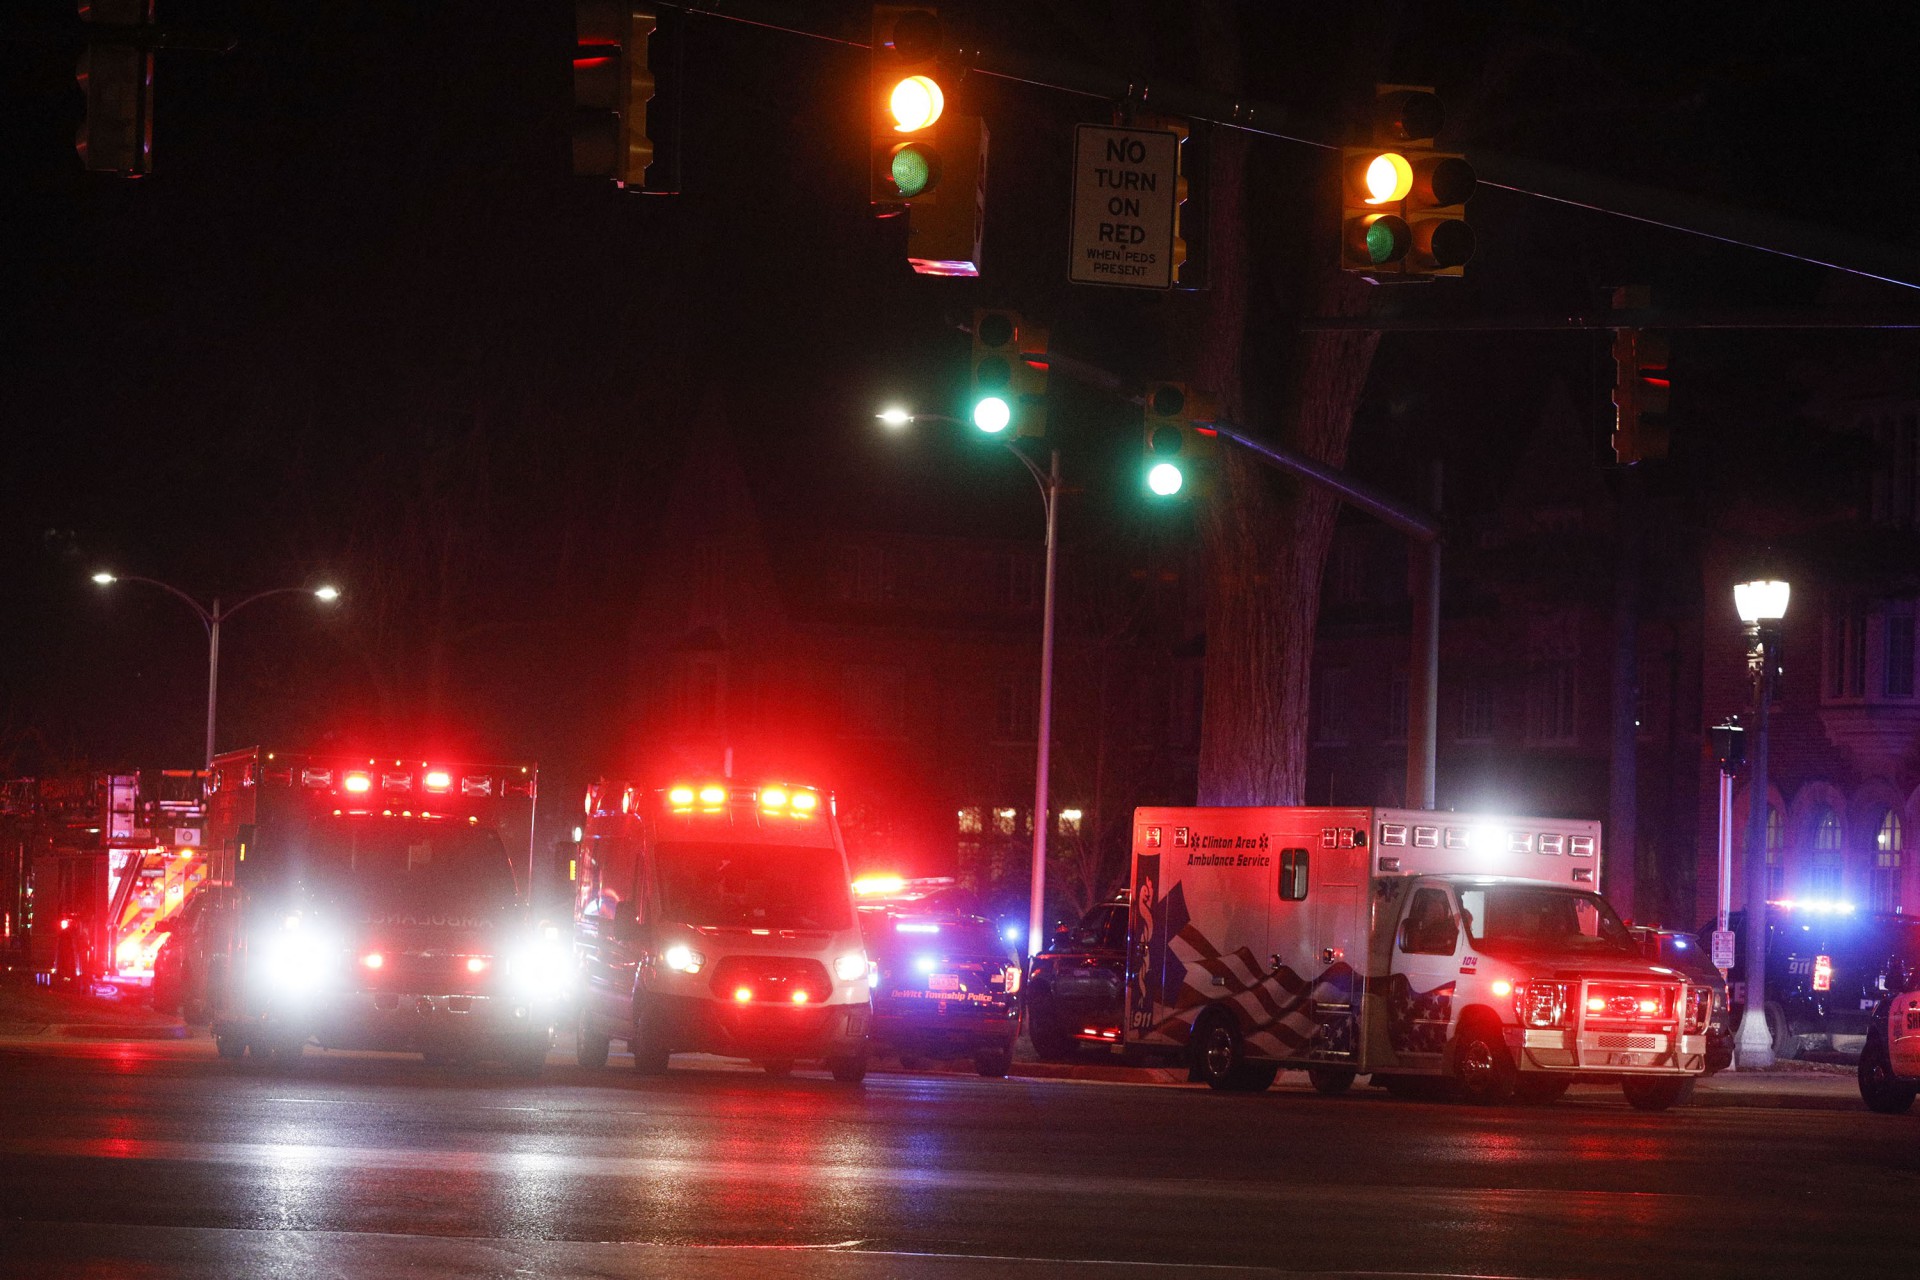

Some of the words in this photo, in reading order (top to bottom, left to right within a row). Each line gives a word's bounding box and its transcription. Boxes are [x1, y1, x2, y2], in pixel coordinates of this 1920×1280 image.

[1107, 139, 1146, 164] NO
[1094, 168, 1156, 192] TURN
[1108, 197, 1140, 218] ON
[1098, 223, 1146, 245] RED
[1087, 248, 1121, 260] WHEN
[1125, 251, 1156, 264] PEDS
[1093, 262, 1148, 276] PRESENT
[1201, 836, 1233, 849] Clinton
[1235, 836, 1257, 849] Area
[1187, 853, 1235, 866] Ambulance
[1236, 854, 1270, 867] Service
[1462, 956, 1478, 966] 104
[1788, 961, 1811, 975] 911
[925, 990, 966, 1001] Township
[967, 992, 993, 1002] Police
[1133, 1011, 1152, 1028] 911
